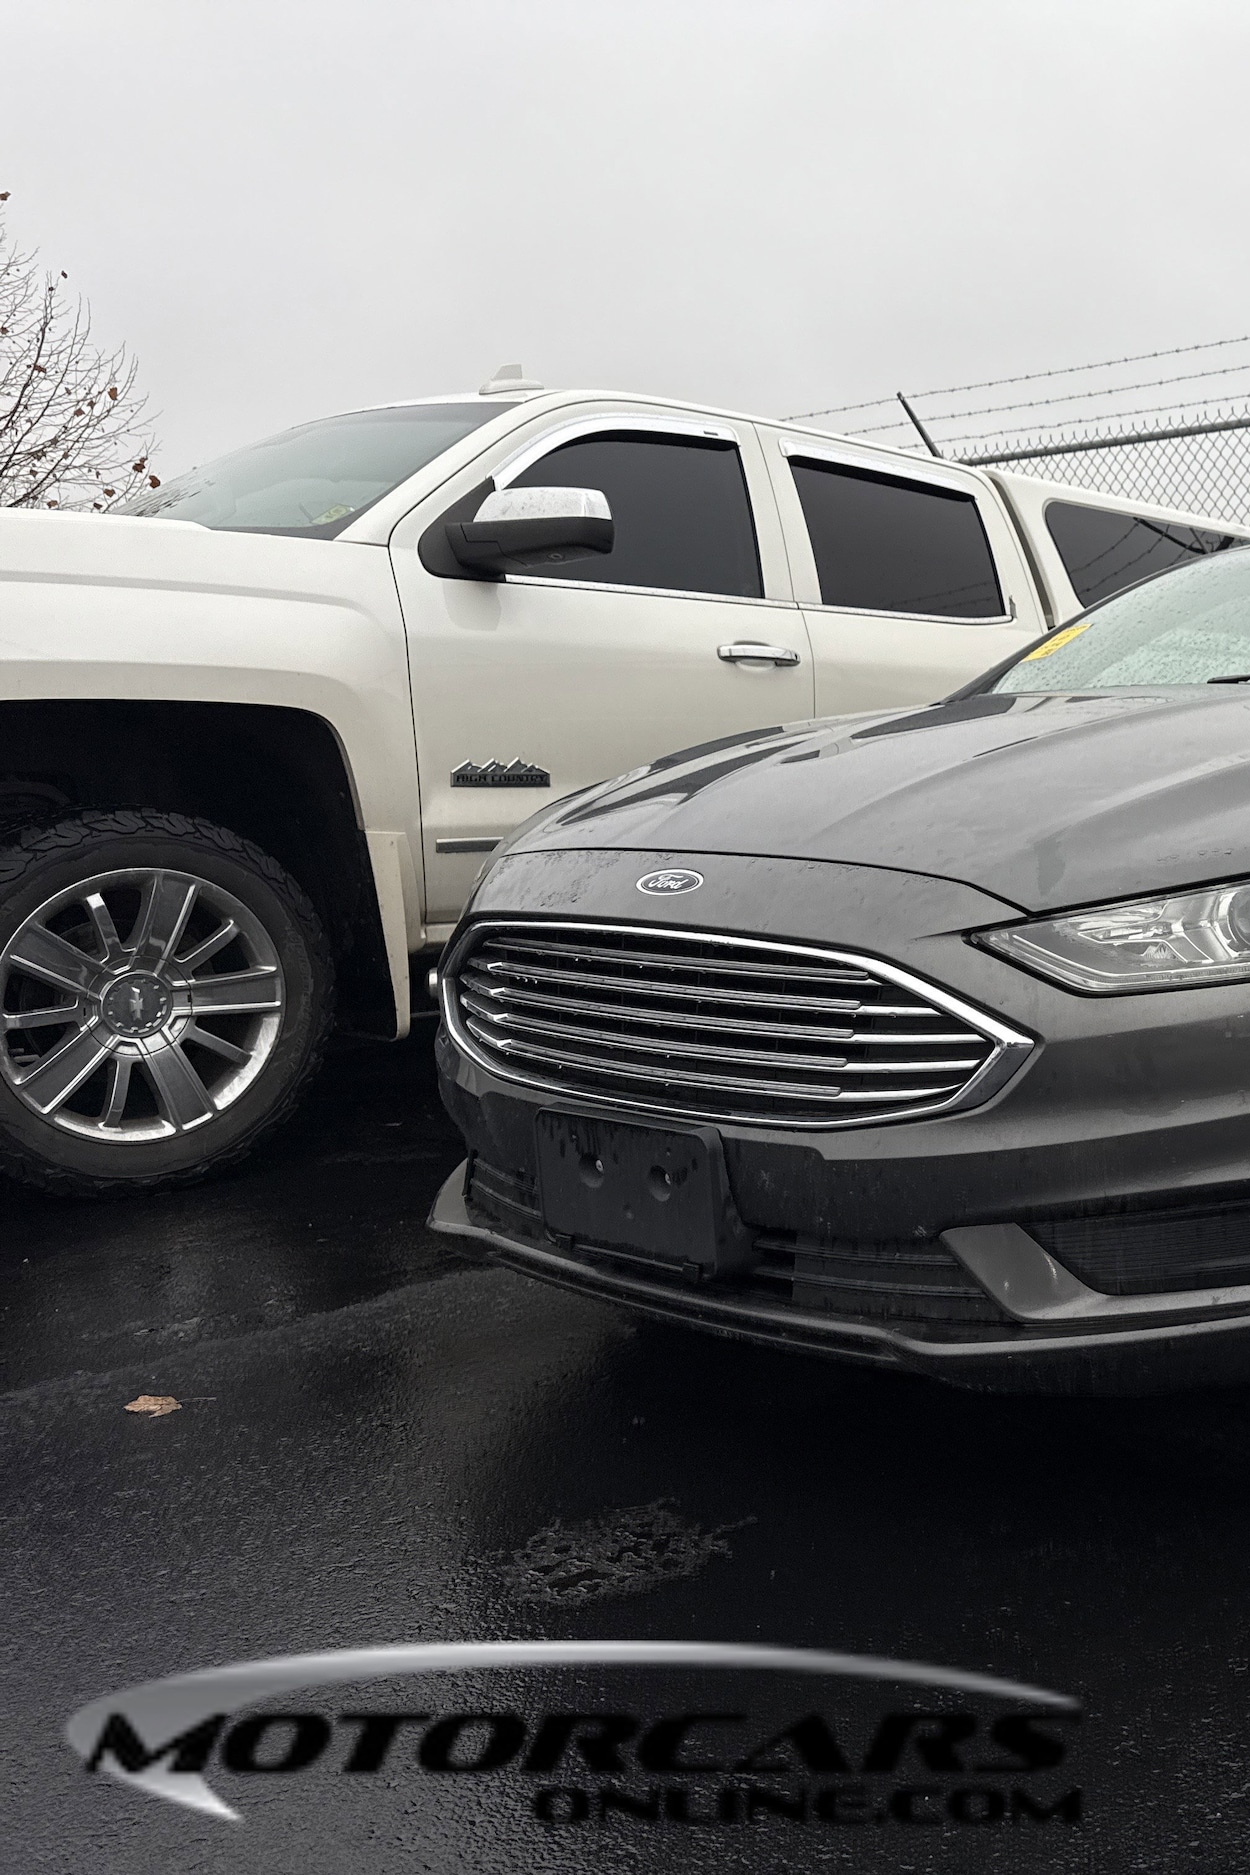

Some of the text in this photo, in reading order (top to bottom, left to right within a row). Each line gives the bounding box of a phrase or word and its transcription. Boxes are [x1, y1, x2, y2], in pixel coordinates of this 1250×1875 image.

[456, 774, 547, 783] HIGH COUNTRY
[648, 873, 689, 889] Ford
